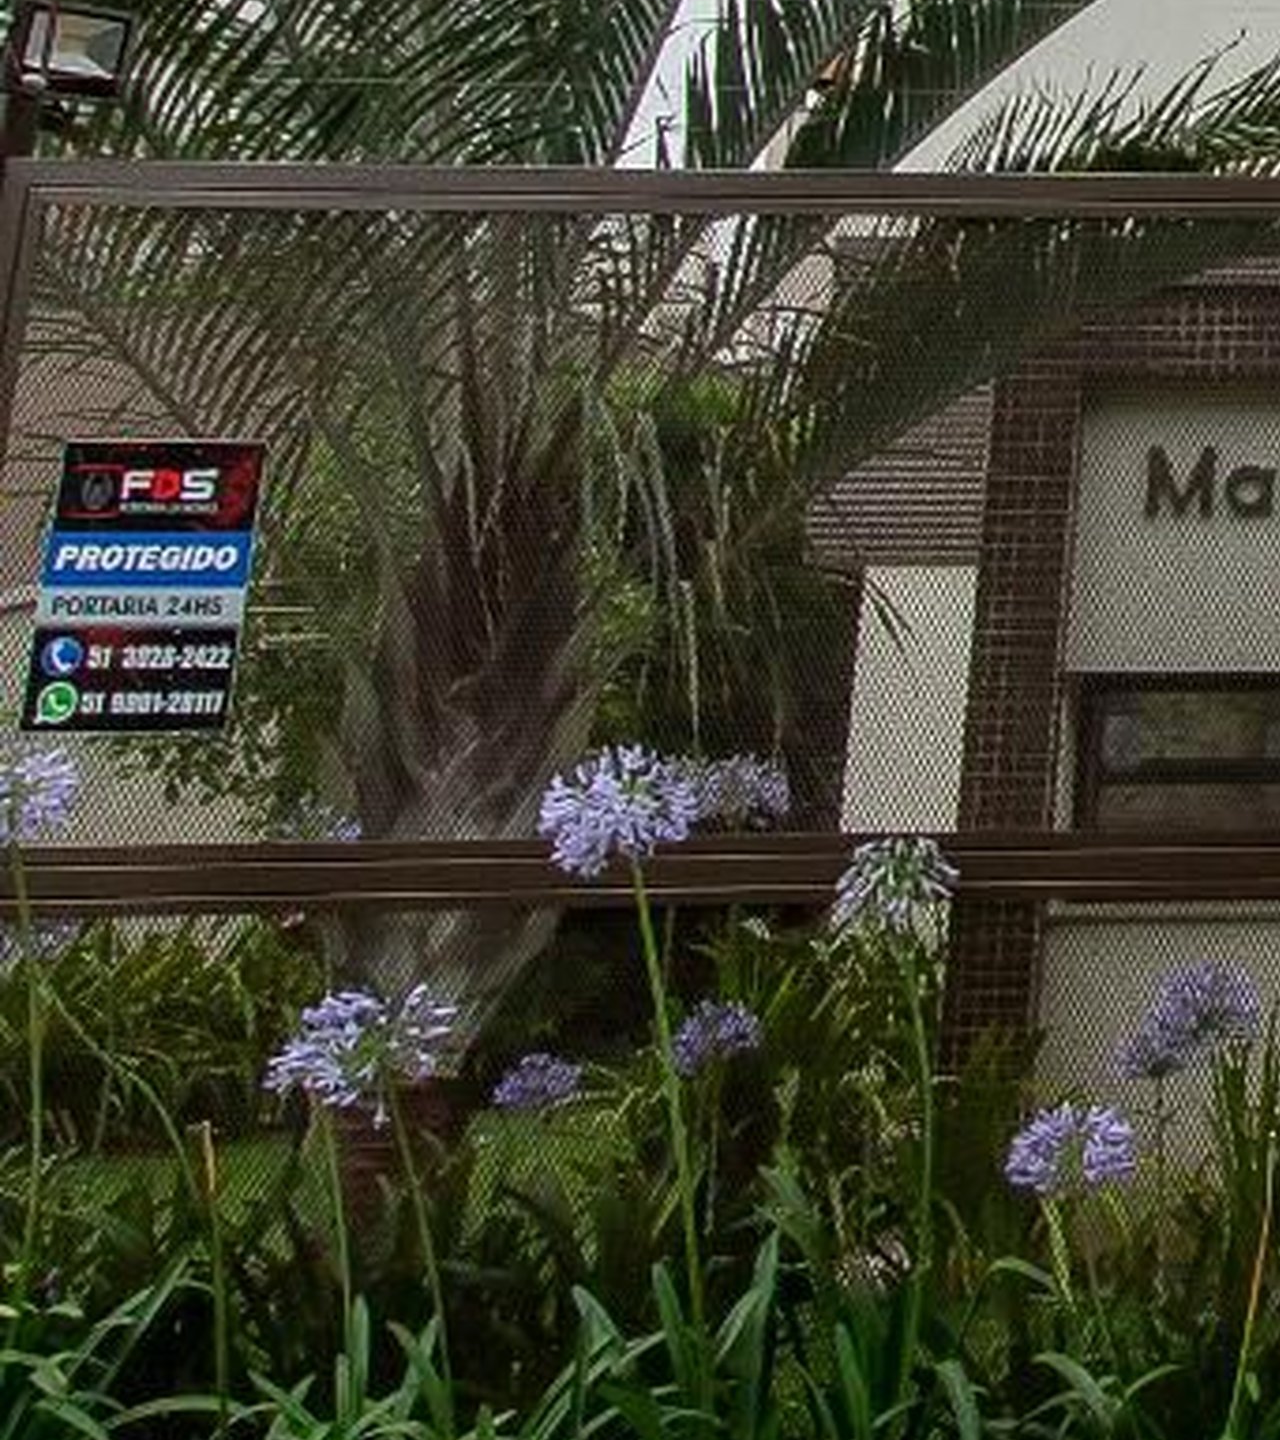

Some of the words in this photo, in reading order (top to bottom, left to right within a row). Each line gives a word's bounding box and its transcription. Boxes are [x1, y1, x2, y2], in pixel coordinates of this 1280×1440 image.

[52, 544, 240, 572] PROTEGIDO
[51, 596, 158, 617] PORTARIA
[166, 595, 223, 617] 24HS
